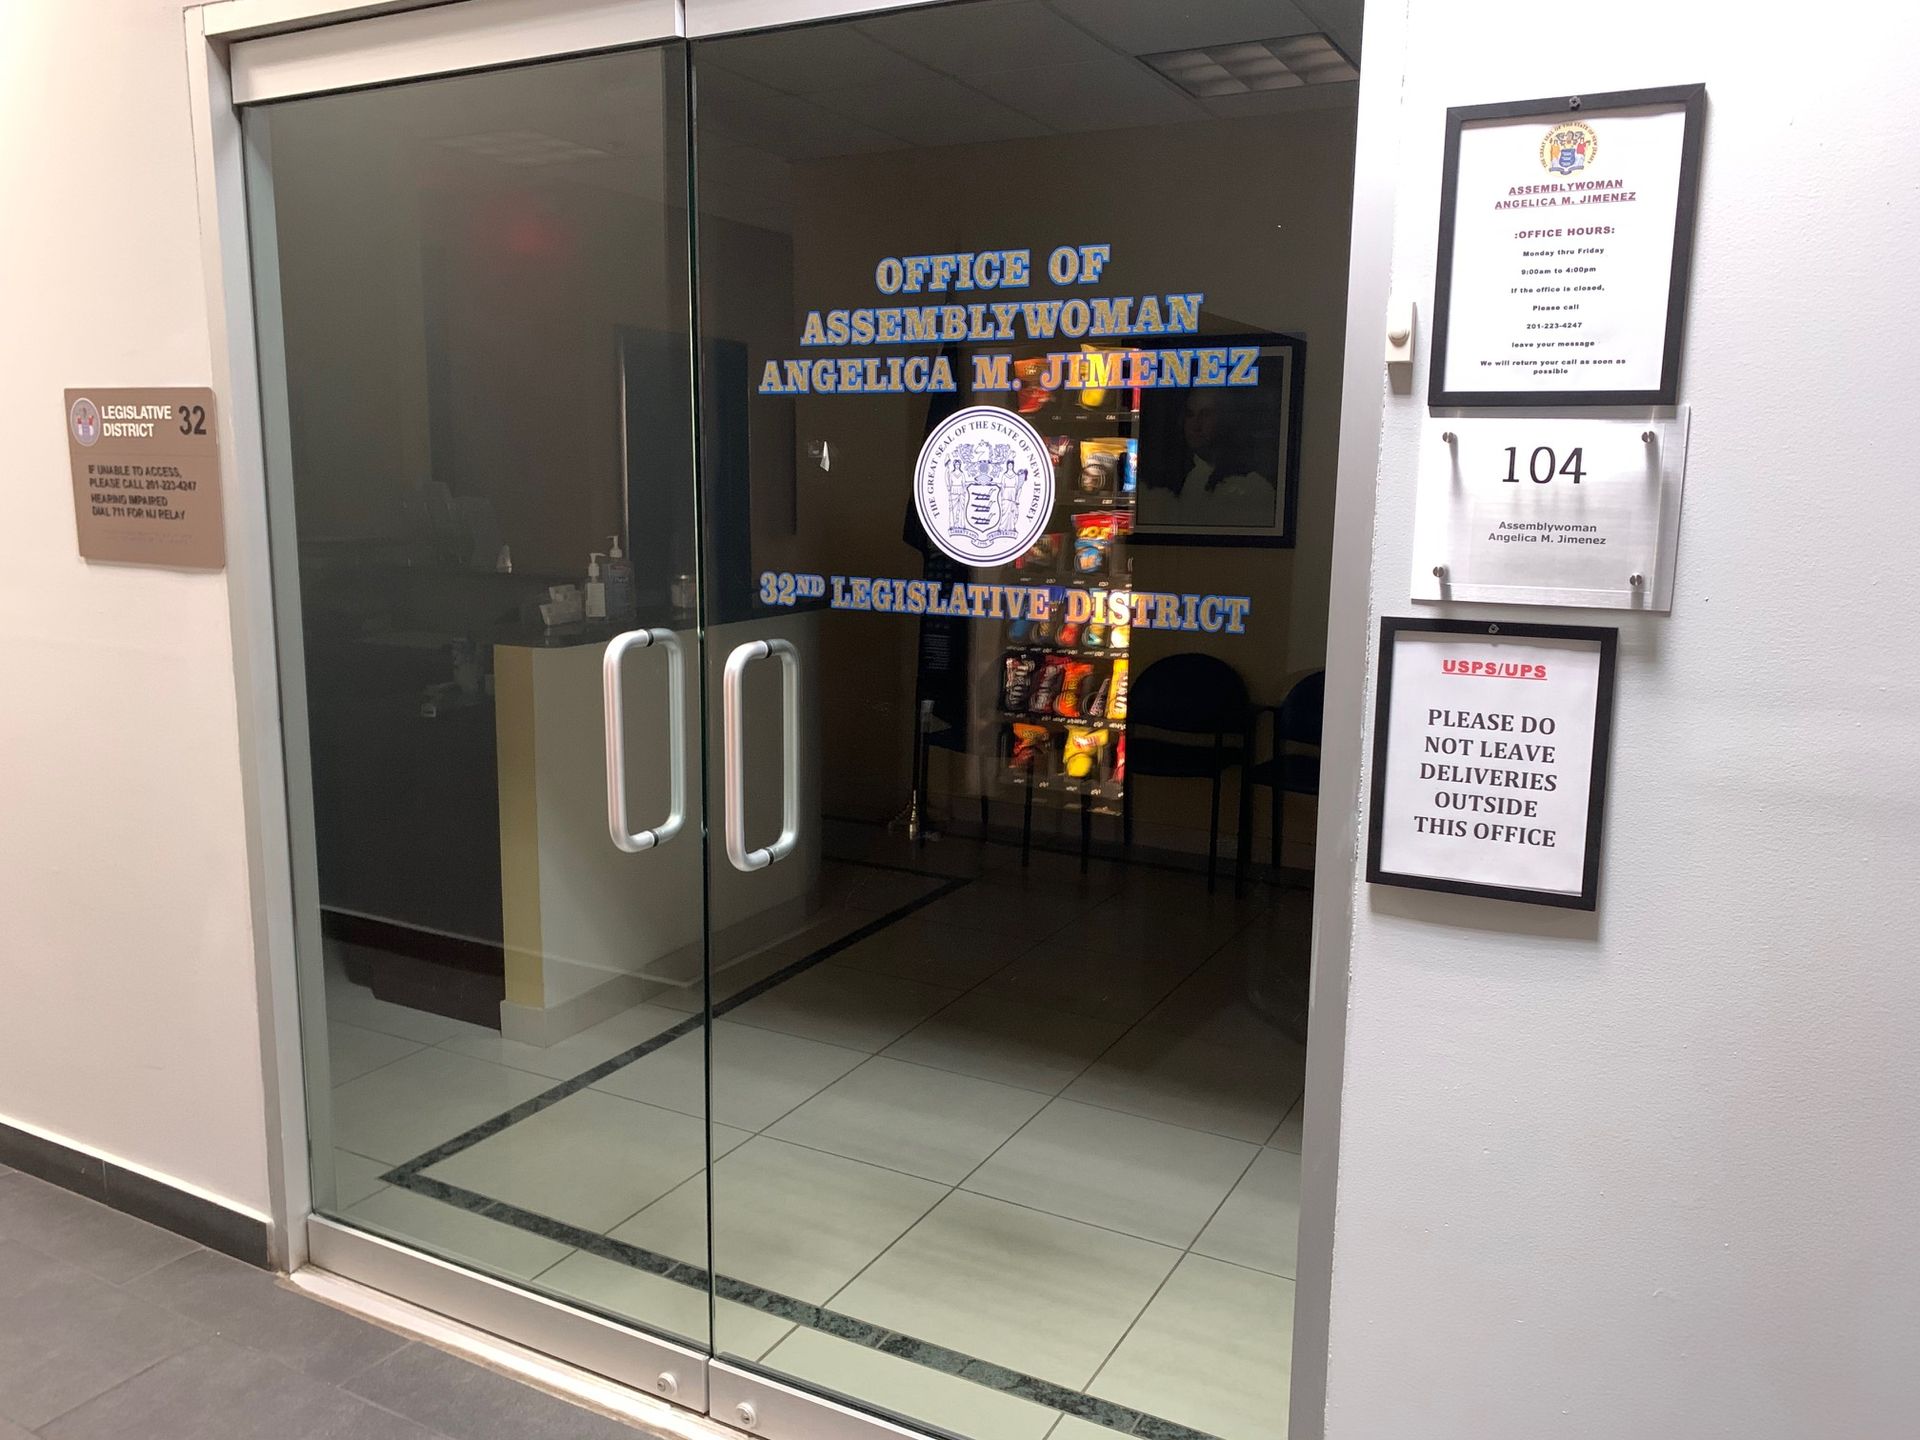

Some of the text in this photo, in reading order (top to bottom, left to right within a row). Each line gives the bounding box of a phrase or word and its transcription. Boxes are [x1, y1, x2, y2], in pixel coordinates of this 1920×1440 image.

[1508, 179, 1623, 196] ASSEMBLYWOMAN
[1494, 191, 1636, 210] ANGELICA M. JIMENEZ
[1567, 226, 1615, 237] HOURS:
[1523, 250, 1554, 258] Monday
[1577, 247, 1604, 256] Friday
[875, 243, 1111, 296] OFFICE OF
[1521, 268, 1551, 276] 9:00am
[1566, 267, 1596, 275] 4:00pm
[800, 293, 1204, 347] ASSEMBLYWOMAN
[1526, 321, 1583, 330] 201-223-4247
[758, 346, 1260, 395] ANGELICA M. JIMENEZ
[101, 405, 207, 436] LEGISLATIVE 32
[103, 423, 154, 437] DISTRICT
[97, 465, 130, 476] UNABLE
[132, 466, 144, 476] TO
[145, 467, 182, 478] ACCESS,
[927, 420, 1041, 524] THE GREAT SEAL OF THE STATE OF NEW JERSEY
[1502, 446, 1587, 484] 104
[89, 478, 121, 489] PLEASE
[122, 479, 144, 489] CALL
[91, 494, 168, 507] HEARING IMPAIRED
[92, 506, 111, 517] DIAL
[112, 506, 125, 517] 711
[127, 507, 144, 518] FOR
[158, 509, 185, 520] RELAY
[1498, 521, 1597, 533] Assemblywoman
[1488, 533, 1607, 545] Angelica M. Jimenez
[830, 575, 1050, 622] LEGISLATIVE
[1067, 590, 1251, 635] DISTRICT
[1442, 659, 1547, 679] USPS/UPS
[1428, 709, 1556, 736] PLEASE DO
[1424, 736, 1556, 764] NOT LEAVE
[1419, 763, 1557, 792] DELIVERIES
[1434, 792, 1538, 818] OUTSIDE
[1414, 816, 1556, 847] THIS OFFICE
